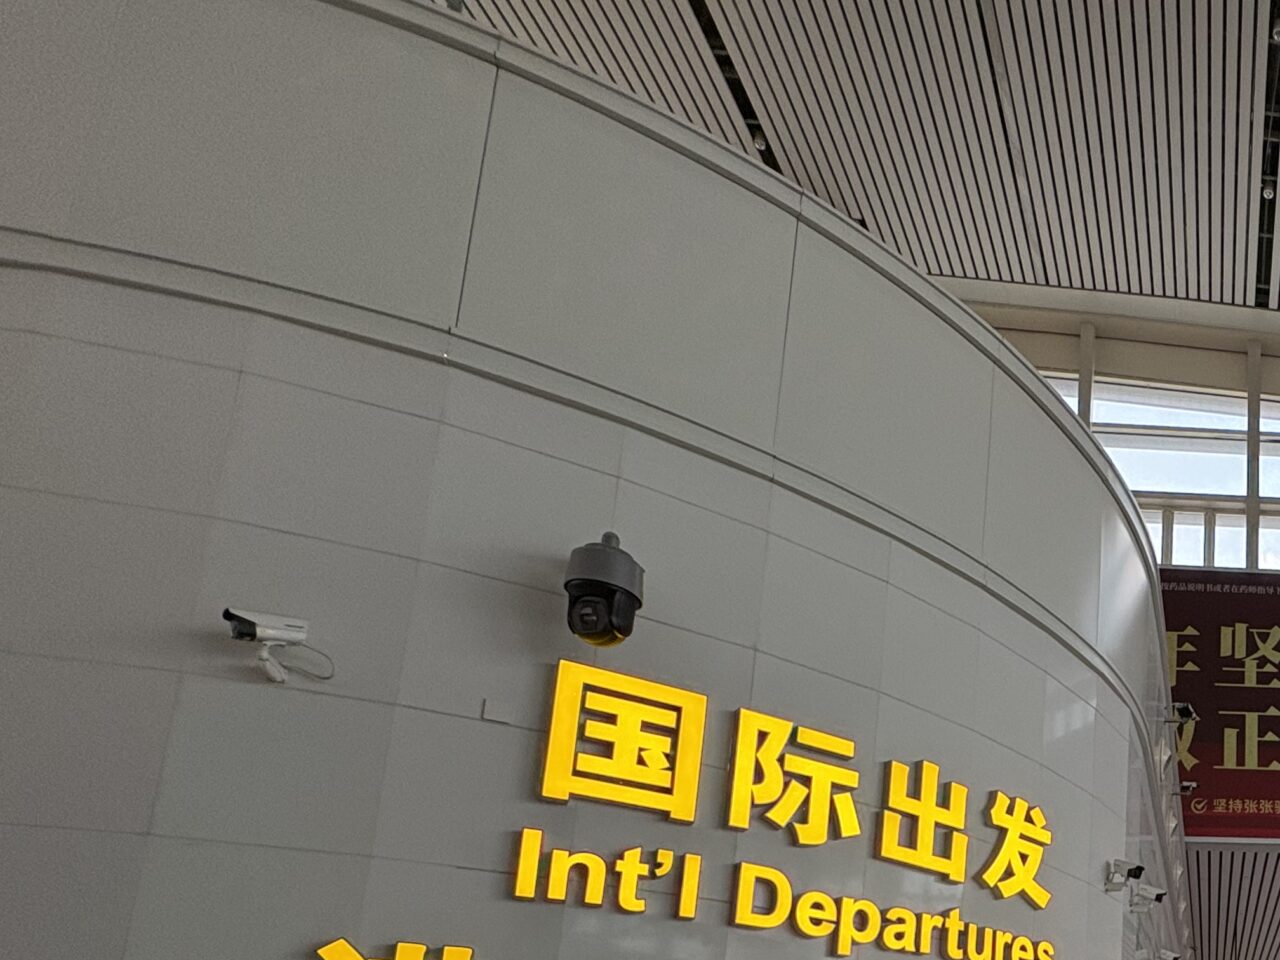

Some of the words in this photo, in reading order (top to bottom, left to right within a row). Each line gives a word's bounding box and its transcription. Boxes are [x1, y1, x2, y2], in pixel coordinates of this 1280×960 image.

[541, 659, 1053, 908] 国际出发
[514, 827, 702, 919] Int'l
